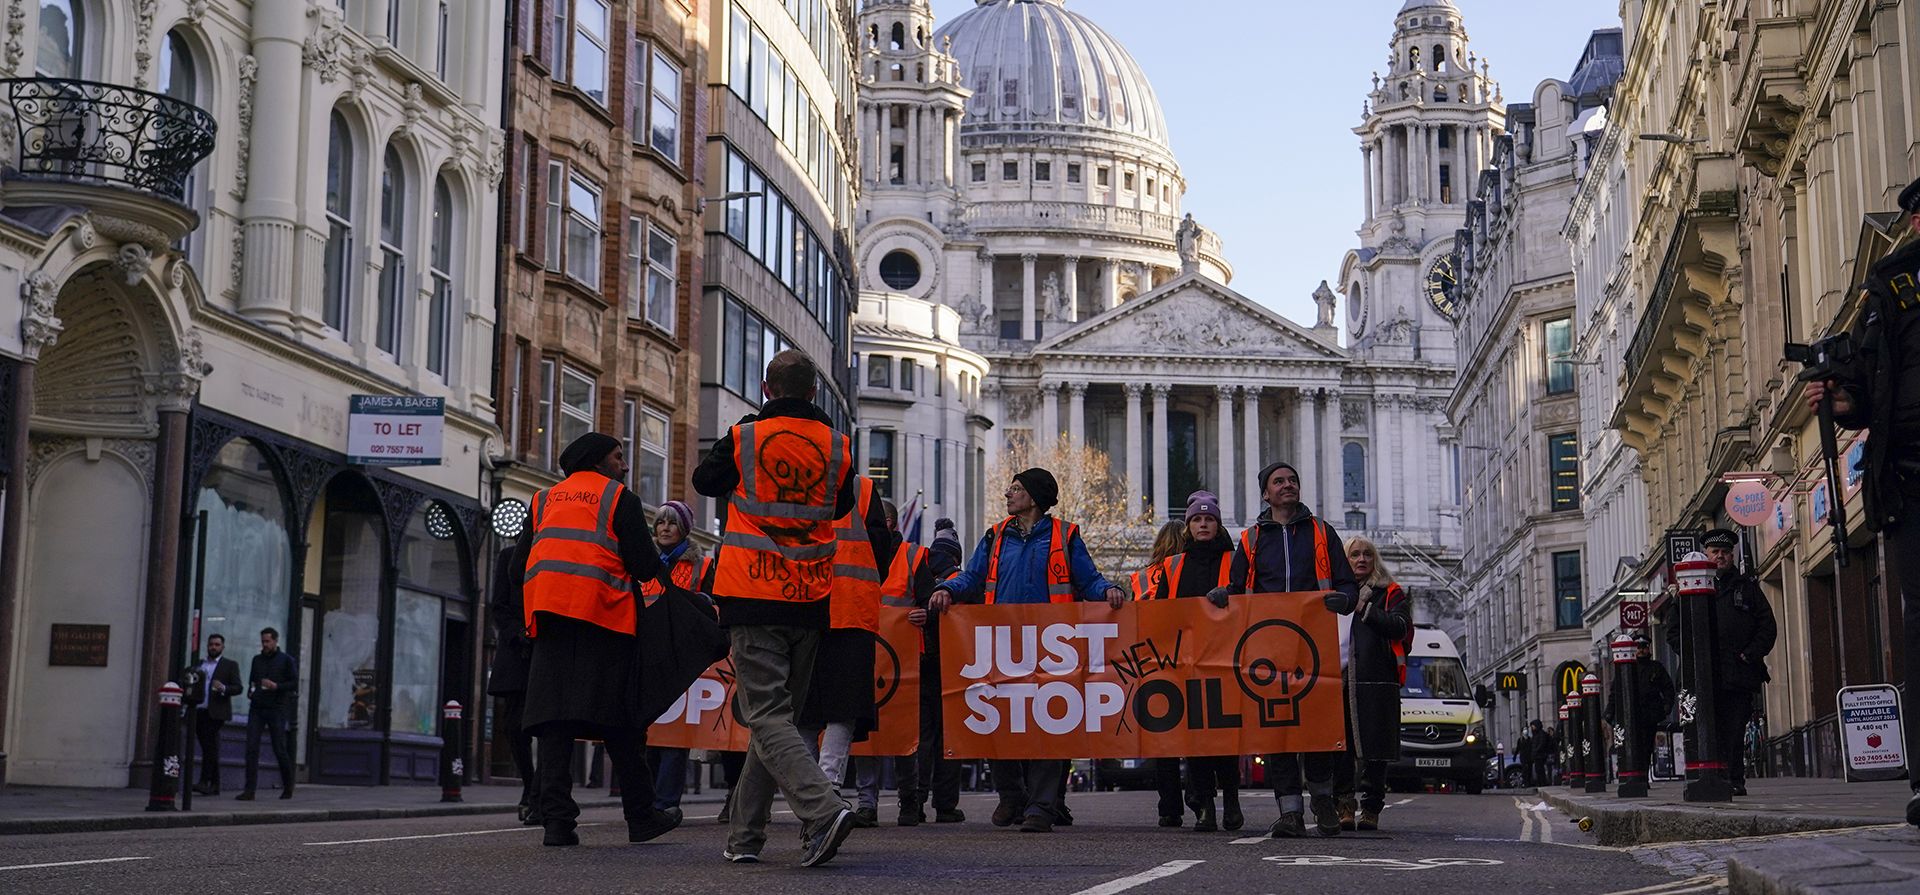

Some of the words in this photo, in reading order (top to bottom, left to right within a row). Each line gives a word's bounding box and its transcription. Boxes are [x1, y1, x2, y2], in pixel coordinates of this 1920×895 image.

[358, 396, 393, 409] JAMES
[395, 398, 403, 406] A
[405, 398, 438, 407] BAKER
[373, 422, 392, 435] TO
[398, 423, 422, 436] LET
[370, 444, 384, 454] 020
[386, 445, 404, 454] 7557
[545, 490, 599, 507] STEWARD
[1745, 492, 1765, 505] POKE
[1732, 502, 1766, 517] HOUSE
[782, 582, 814, 600] OIL
[959, 623, 1118, 679] JUST
[1111, 629, 1182, 684] NEW
[963, 681, 1125, 736] STOP
[1136, 678, 1243, 733] OIL
[1850, 708, 1891, 717] AVAILABLE
